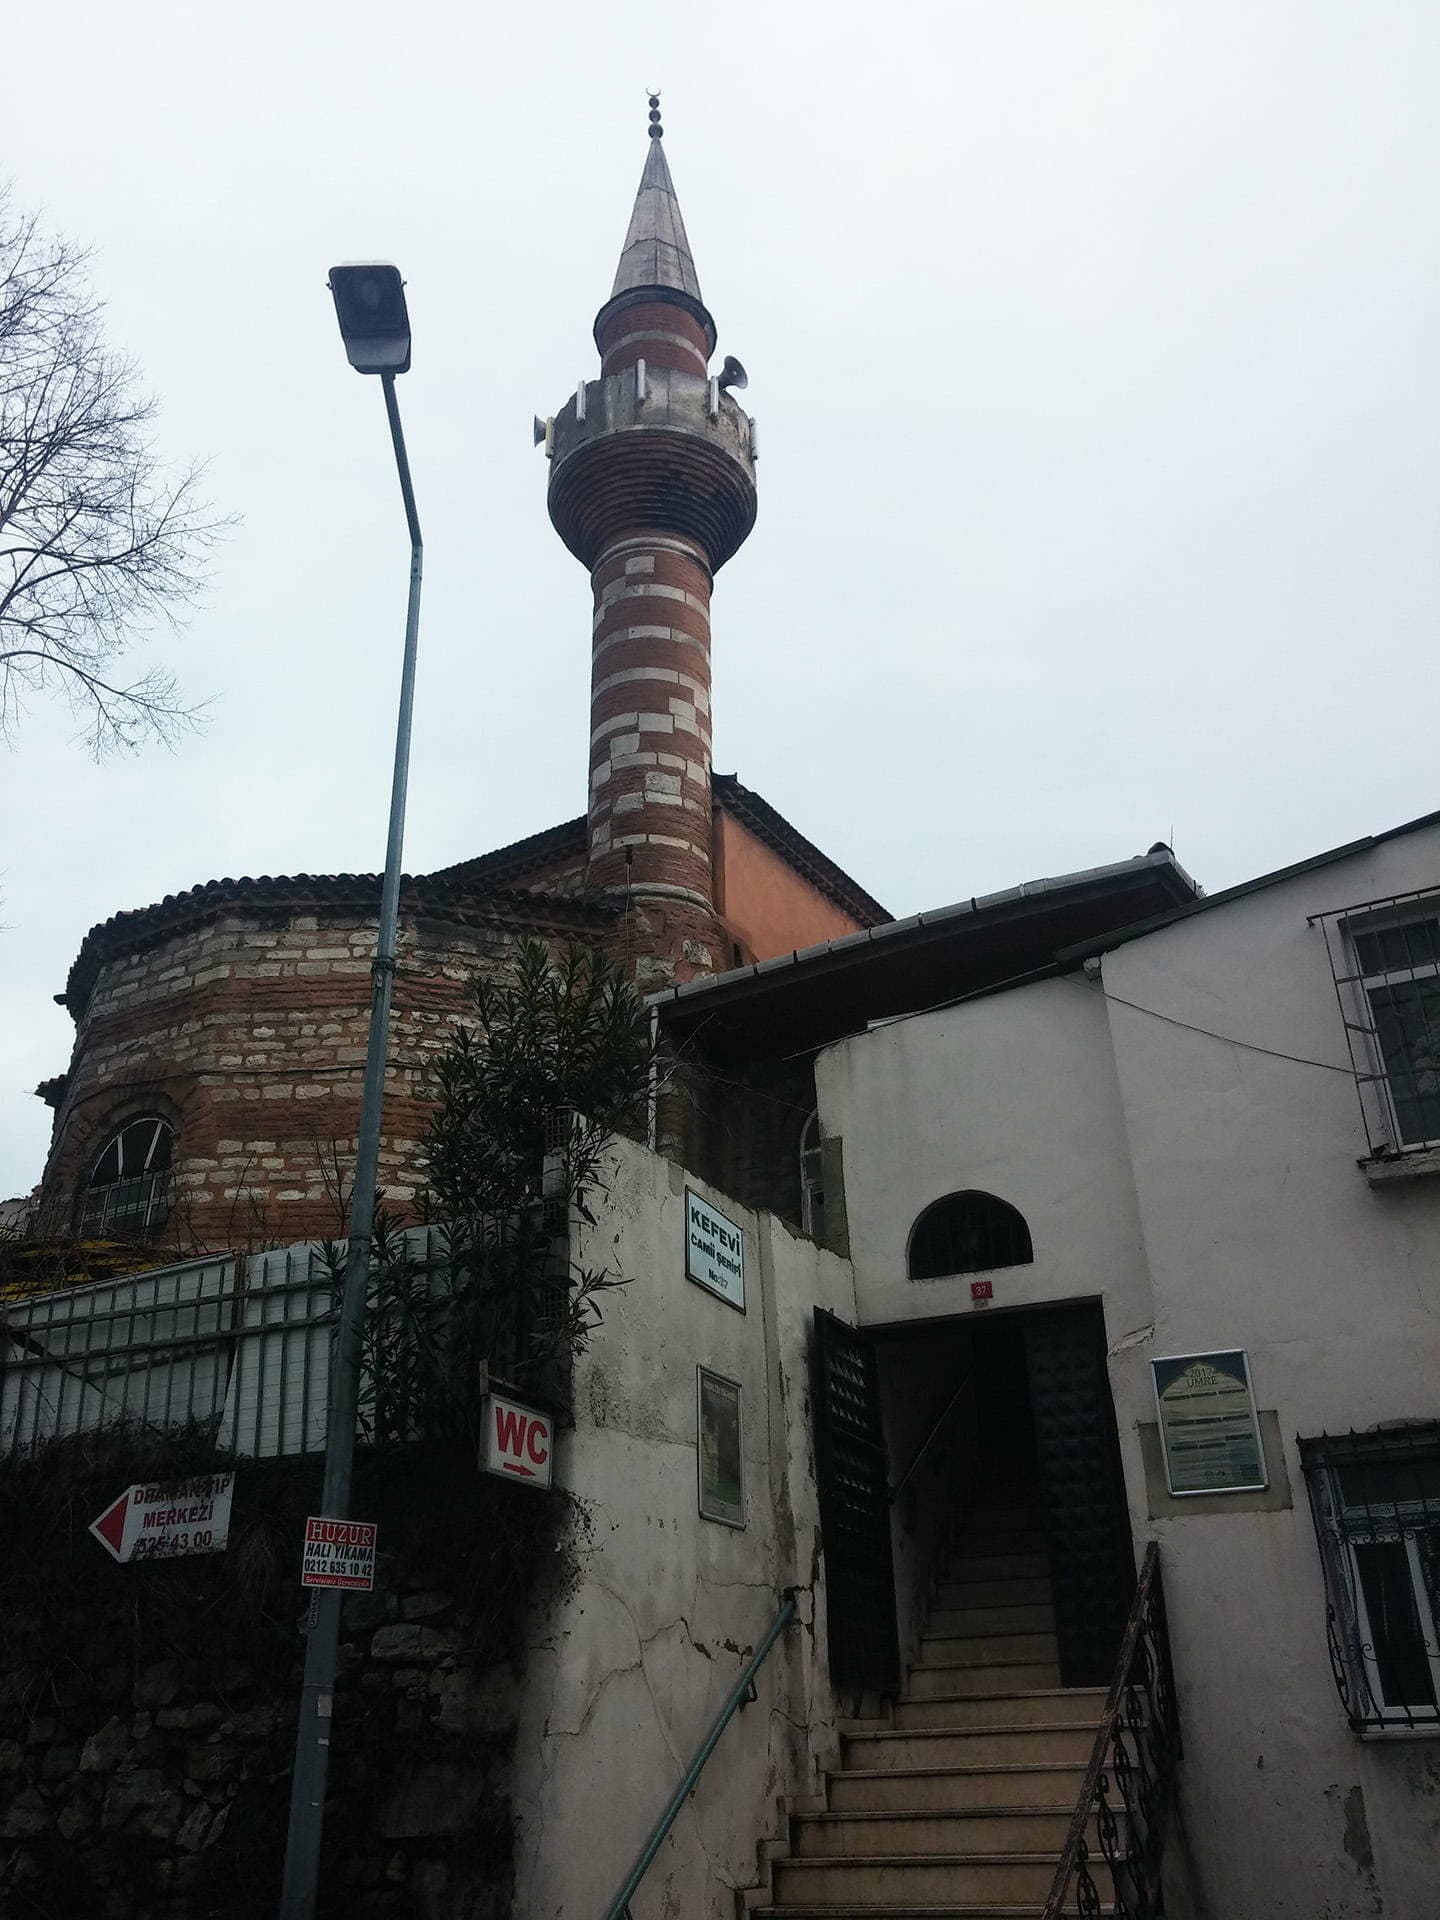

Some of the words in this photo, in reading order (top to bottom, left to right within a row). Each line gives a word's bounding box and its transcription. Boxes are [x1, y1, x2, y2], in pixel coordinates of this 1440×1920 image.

[691, 1206, 740, 1256] KEFEVİ
[975, 1285, 987, 1296] 37
[1186, 1375, 1218, 1388] UMRE
[1189, 1367, 1213, 1378] 2017
[495, 1406, 548, 1465] WC
[143, 1500, 214, 1528] MERKEZİ
[170, 1532, 189, 1551] 43
[193, 1530, 212, 1547] 00
[310, 1521, 373, 1545] HUZUR
[305, 1542, 332, 1558] HALI
[335, 1545, 373, 1562] YIKAMA
[304, 1558, 328, 1573] 0212
[329, 1561, 347, 1575] 635
[350, 1563, 360, 1576] 10
[361, 1564, 373, 1577] 42
